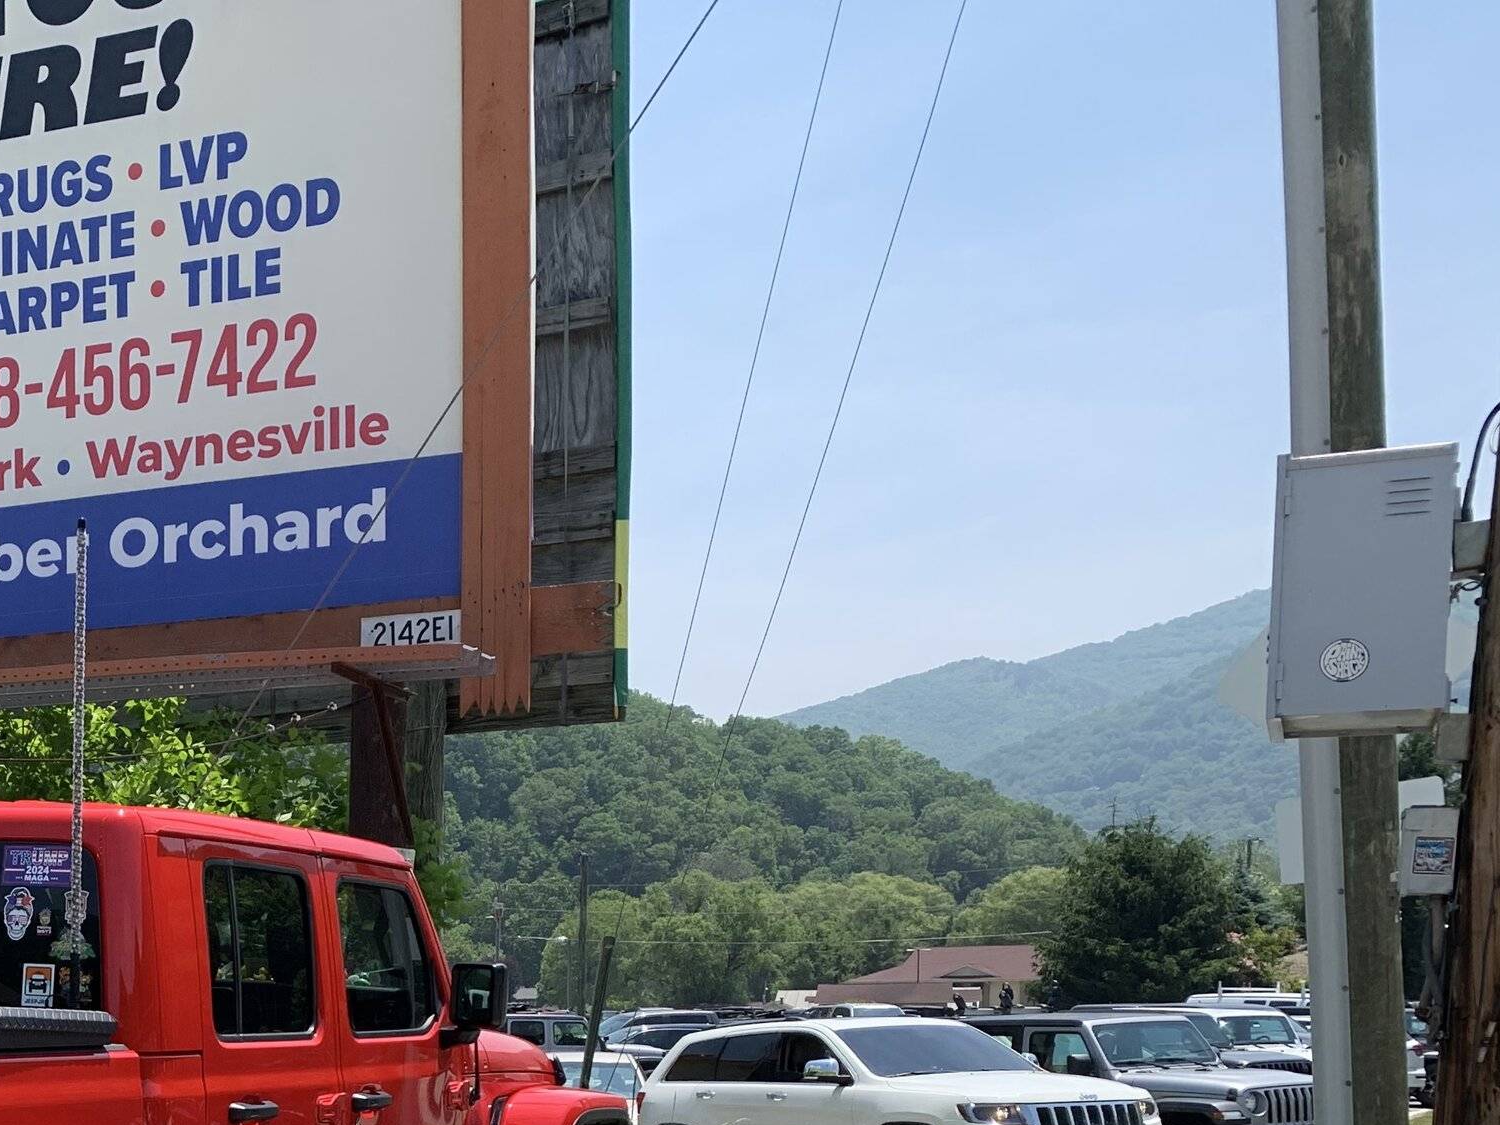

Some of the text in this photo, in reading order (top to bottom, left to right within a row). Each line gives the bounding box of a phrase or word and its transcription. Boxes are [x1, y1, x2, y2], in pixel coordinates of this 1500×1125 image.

[158, 130, 248, 191] LVP
[179, 176, 340, 246] WOOD
[180, 247, 281, 308] TILE
[85, 404, 389, 481] Waynesville
[109, 487, 387, 568] Orchard
[9, 849, 69, 866] TRUMP
[26, 866, 50, 874] 2024
